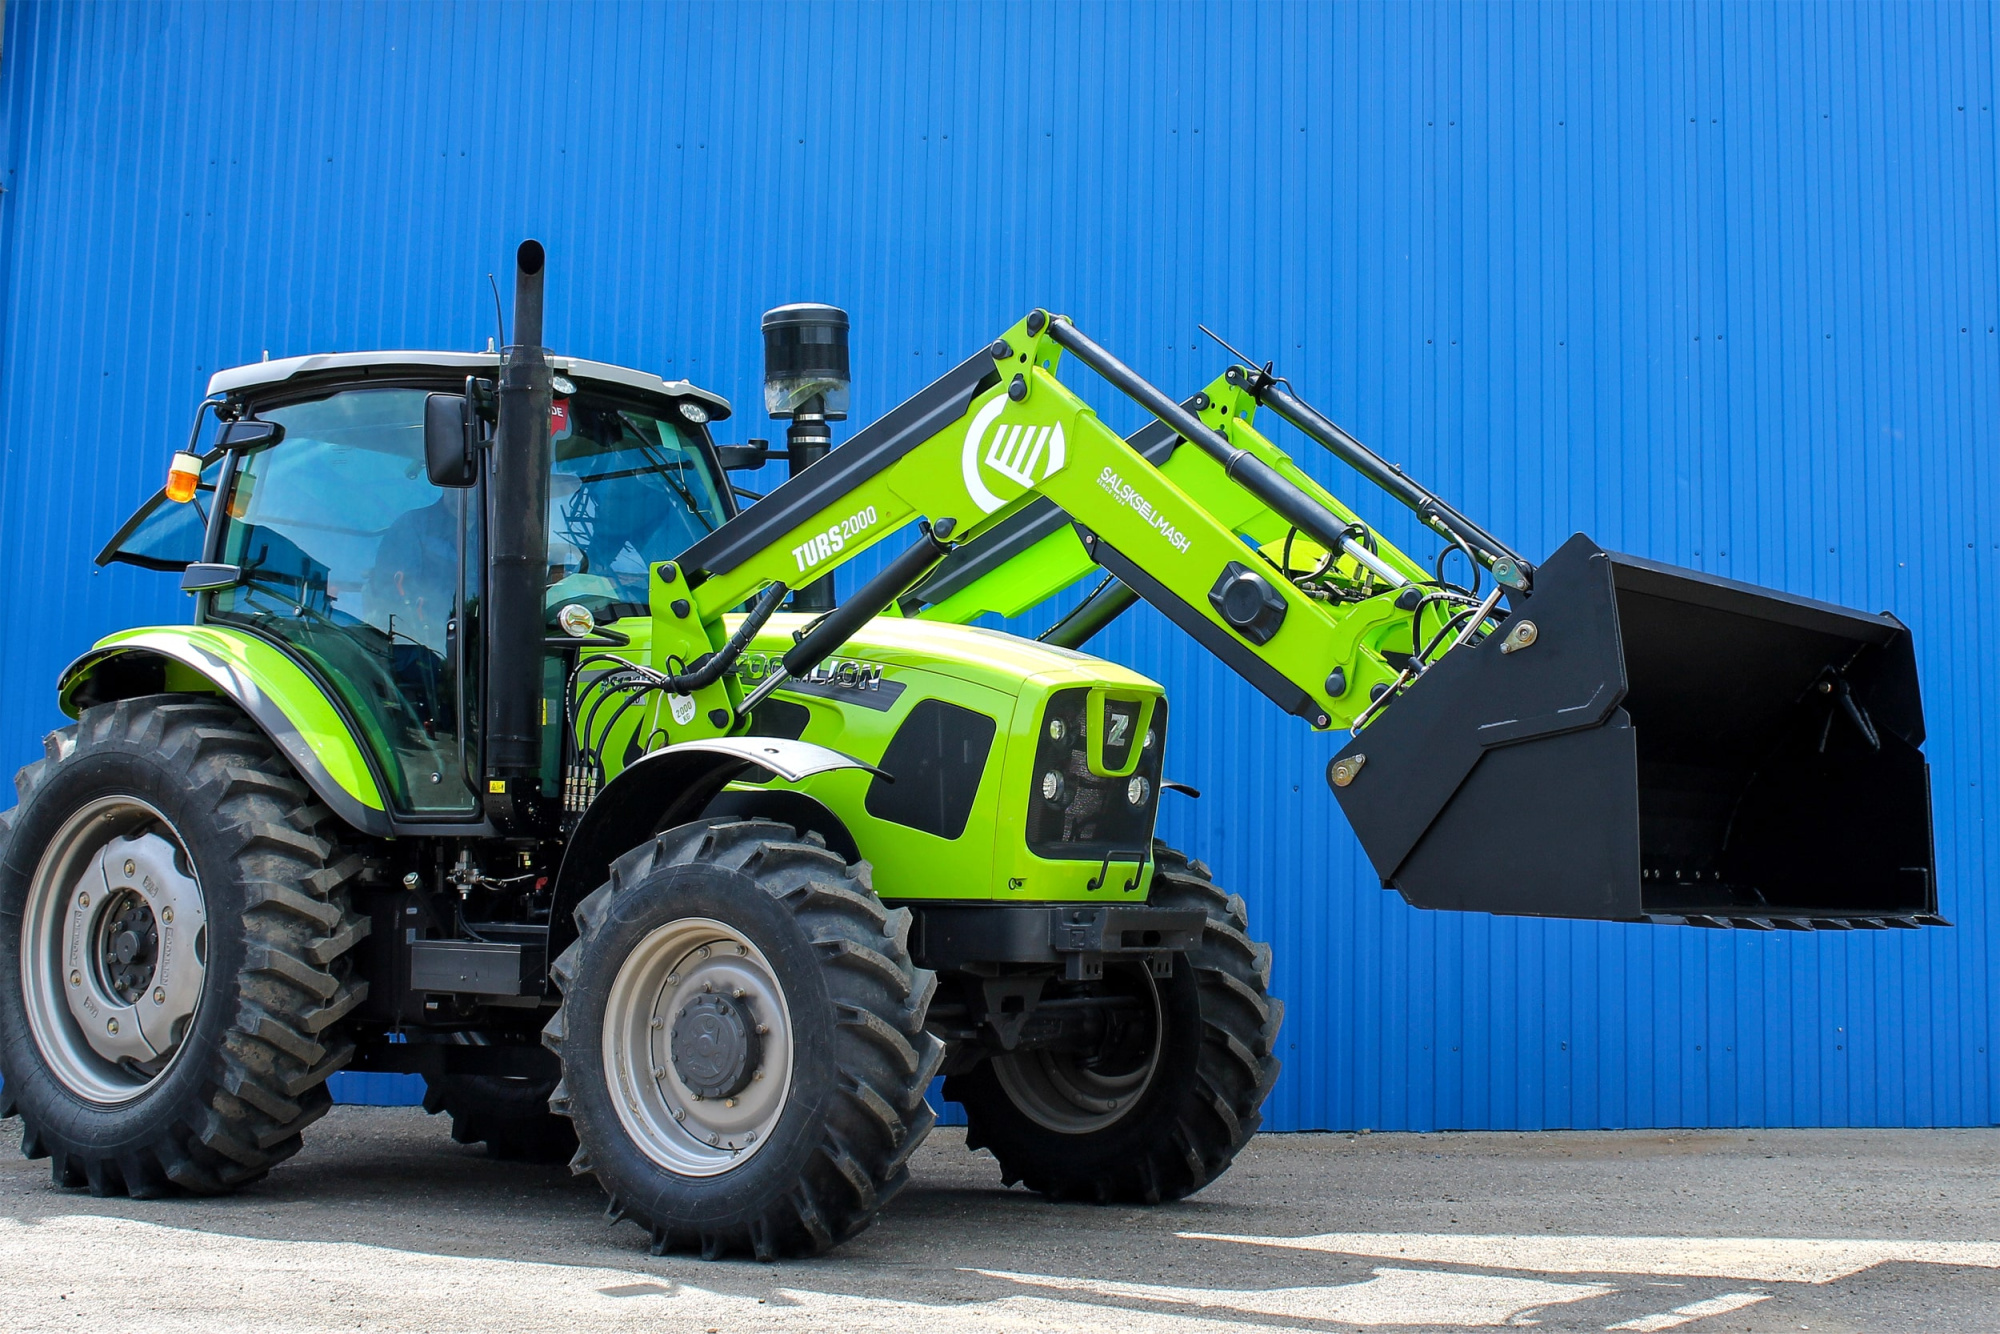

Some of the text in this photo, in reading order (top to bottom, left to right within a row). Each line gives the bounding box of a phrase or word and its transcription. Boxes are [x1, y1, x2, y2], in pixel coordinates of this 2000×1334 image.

[551, 406, 564, 417] DE
[1096, 477, 1113, 495] SINCE
[1100, 466, 1191, 554] SALSKSELMASH
[676, 701, 692, 718] 2000
[683, 712, 691, 722] KG
